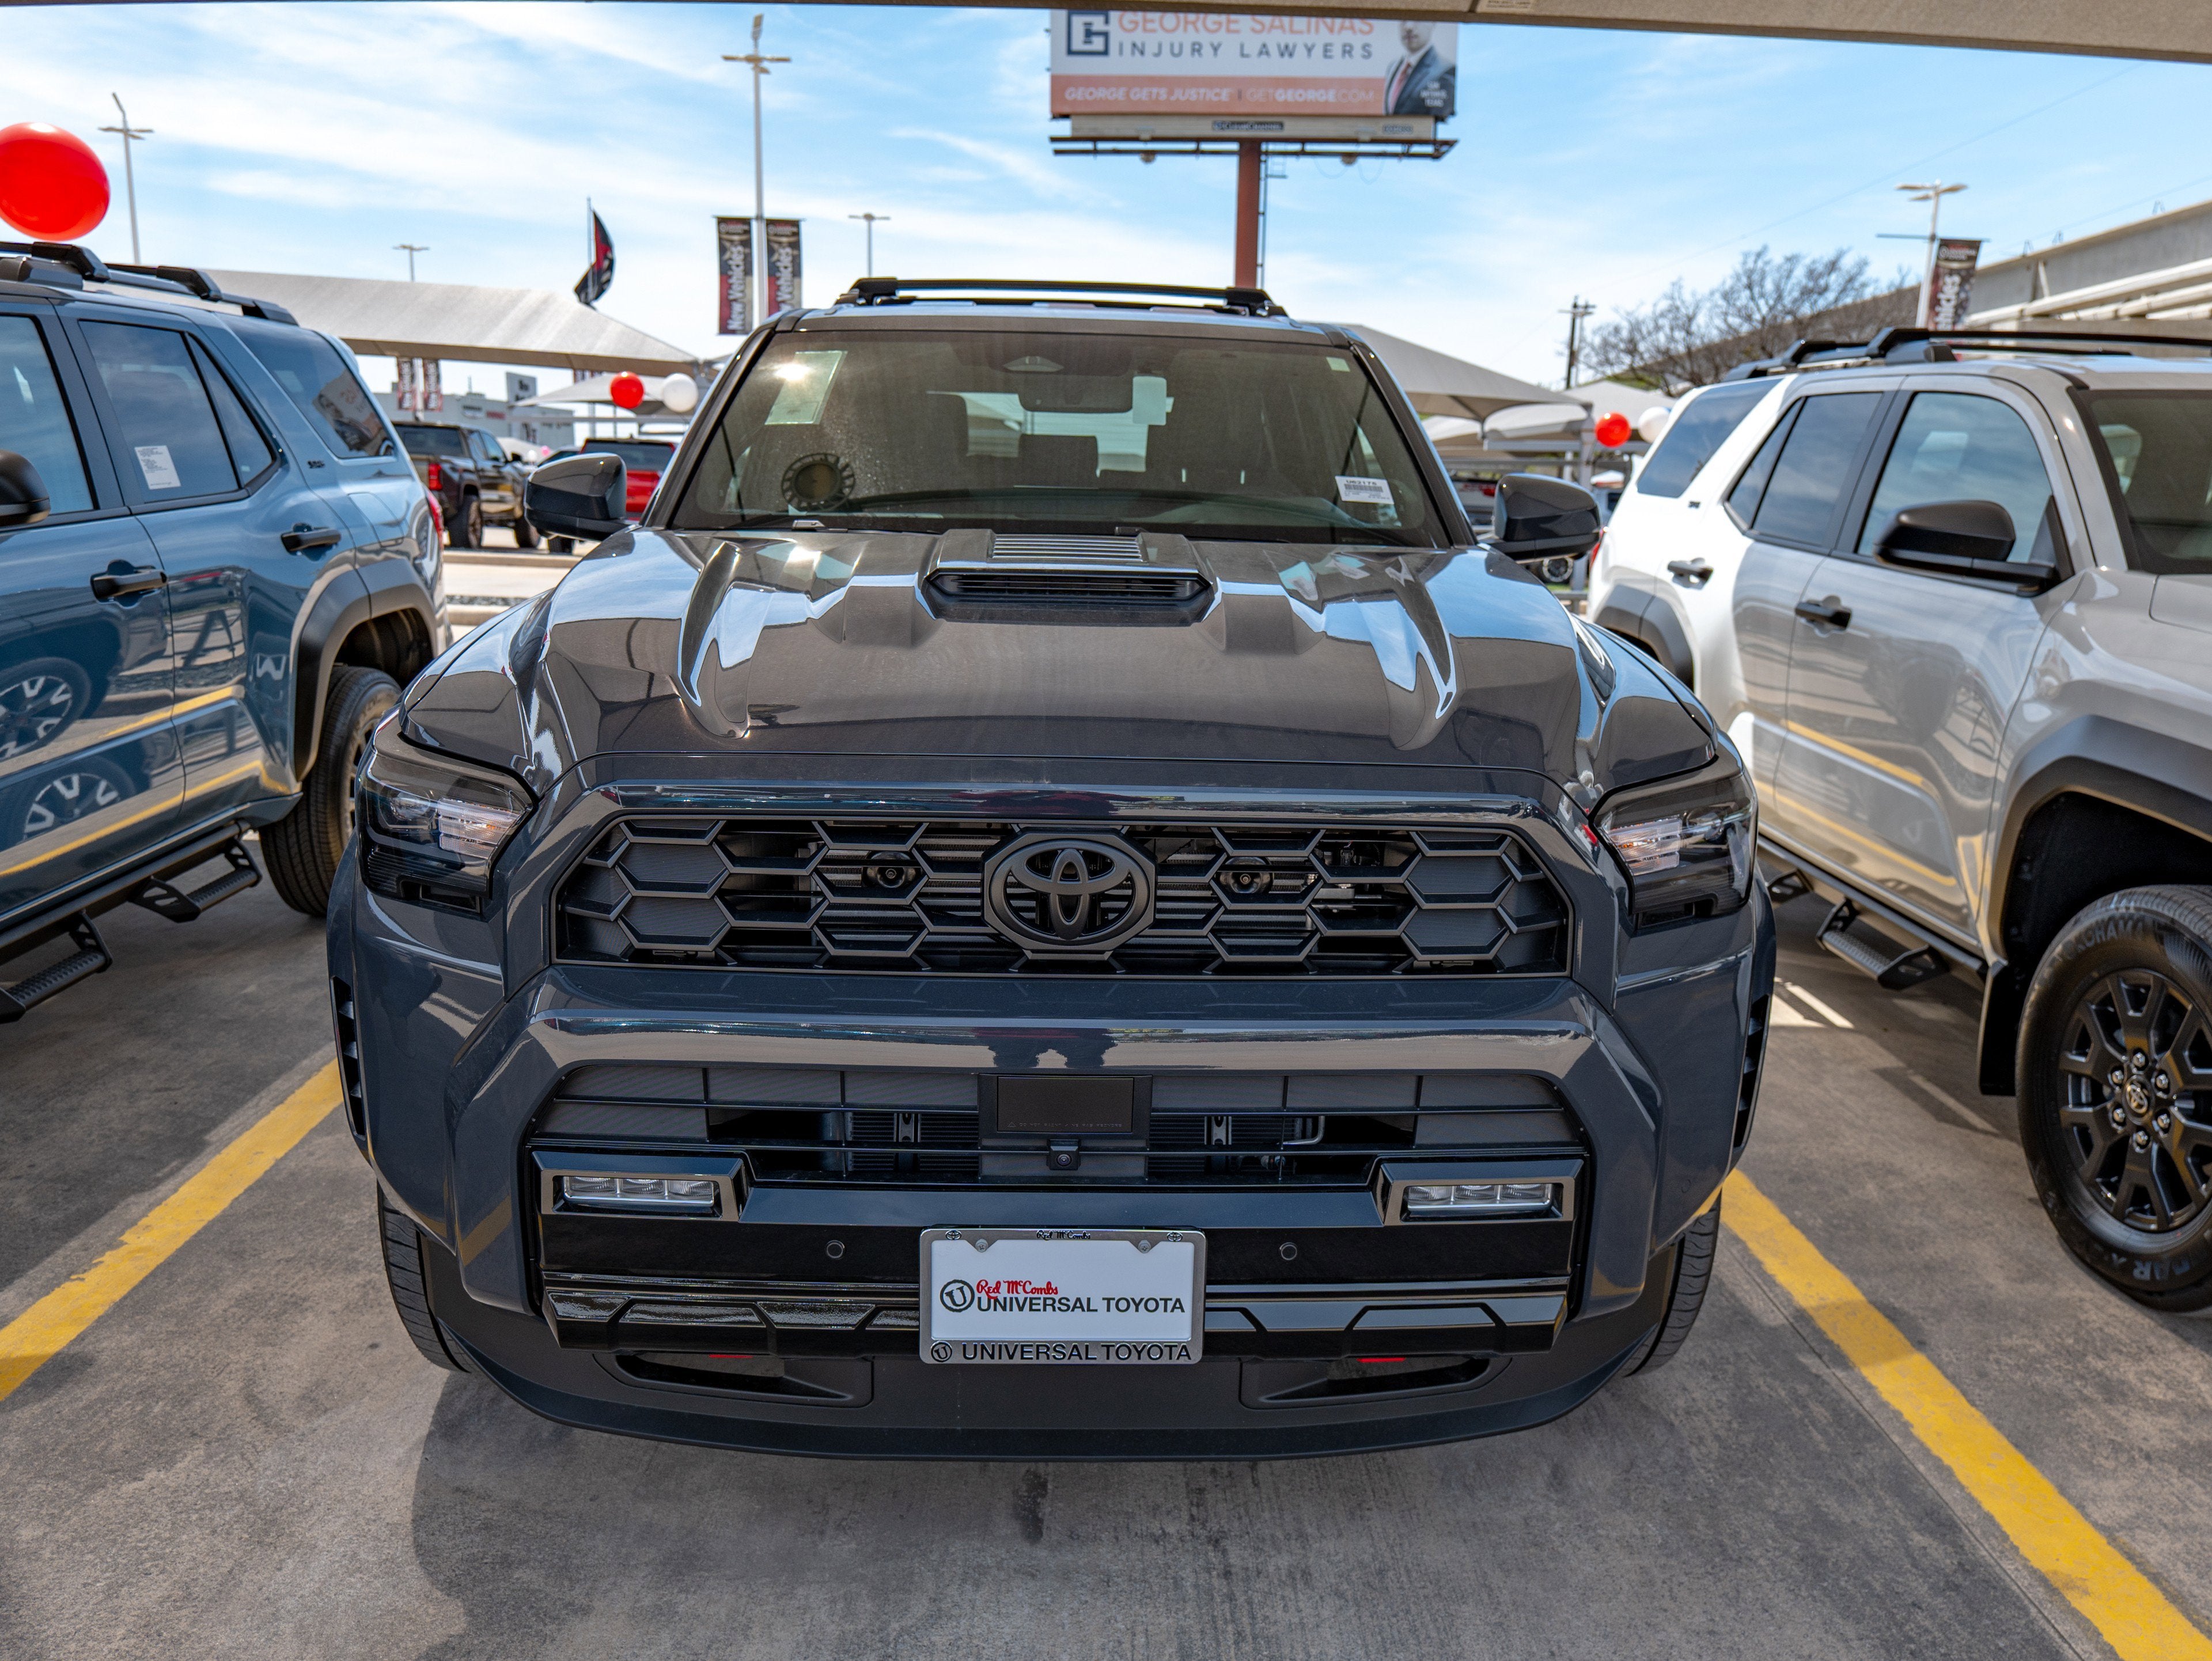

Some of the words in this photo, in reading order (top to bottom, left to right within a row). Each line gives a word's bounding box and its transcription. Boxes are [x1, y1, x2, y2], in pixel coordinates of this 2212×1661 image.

[1118, 12, 1240, 33] GEORGE
[1250, 15, 1374, 35] SALINAS
[1119, 41, 1222, 58] INJURY
[1240, 42, 1372, 59] LAWYERS
[1065, 87, 1127, 101] GEORGE
[1129, 87, 1167, 101] GETS
[1170, 88, 1232, 101] JUSTICE
[727, 245, 745, 300] Vehicles
[775, 246, 794, 302] Vehicles
[727, 301, 745, 330] New
[1036, 1230, 1052, 1240] Red
[1053, 1230, 1091, 1239] McCombs
[976, 1279, 1002, 1299] Red
[1003, 1280, 1058, 1295] McCombs
[977, 1297, 1097, 1312] UNIVERSAL
[1103, 1297, 1185, 1312] TOYOTA
[962, 1343, 1097, 1360] UNIVERSAL
[1101, 1343, 1191, 1360] TOYOTA
